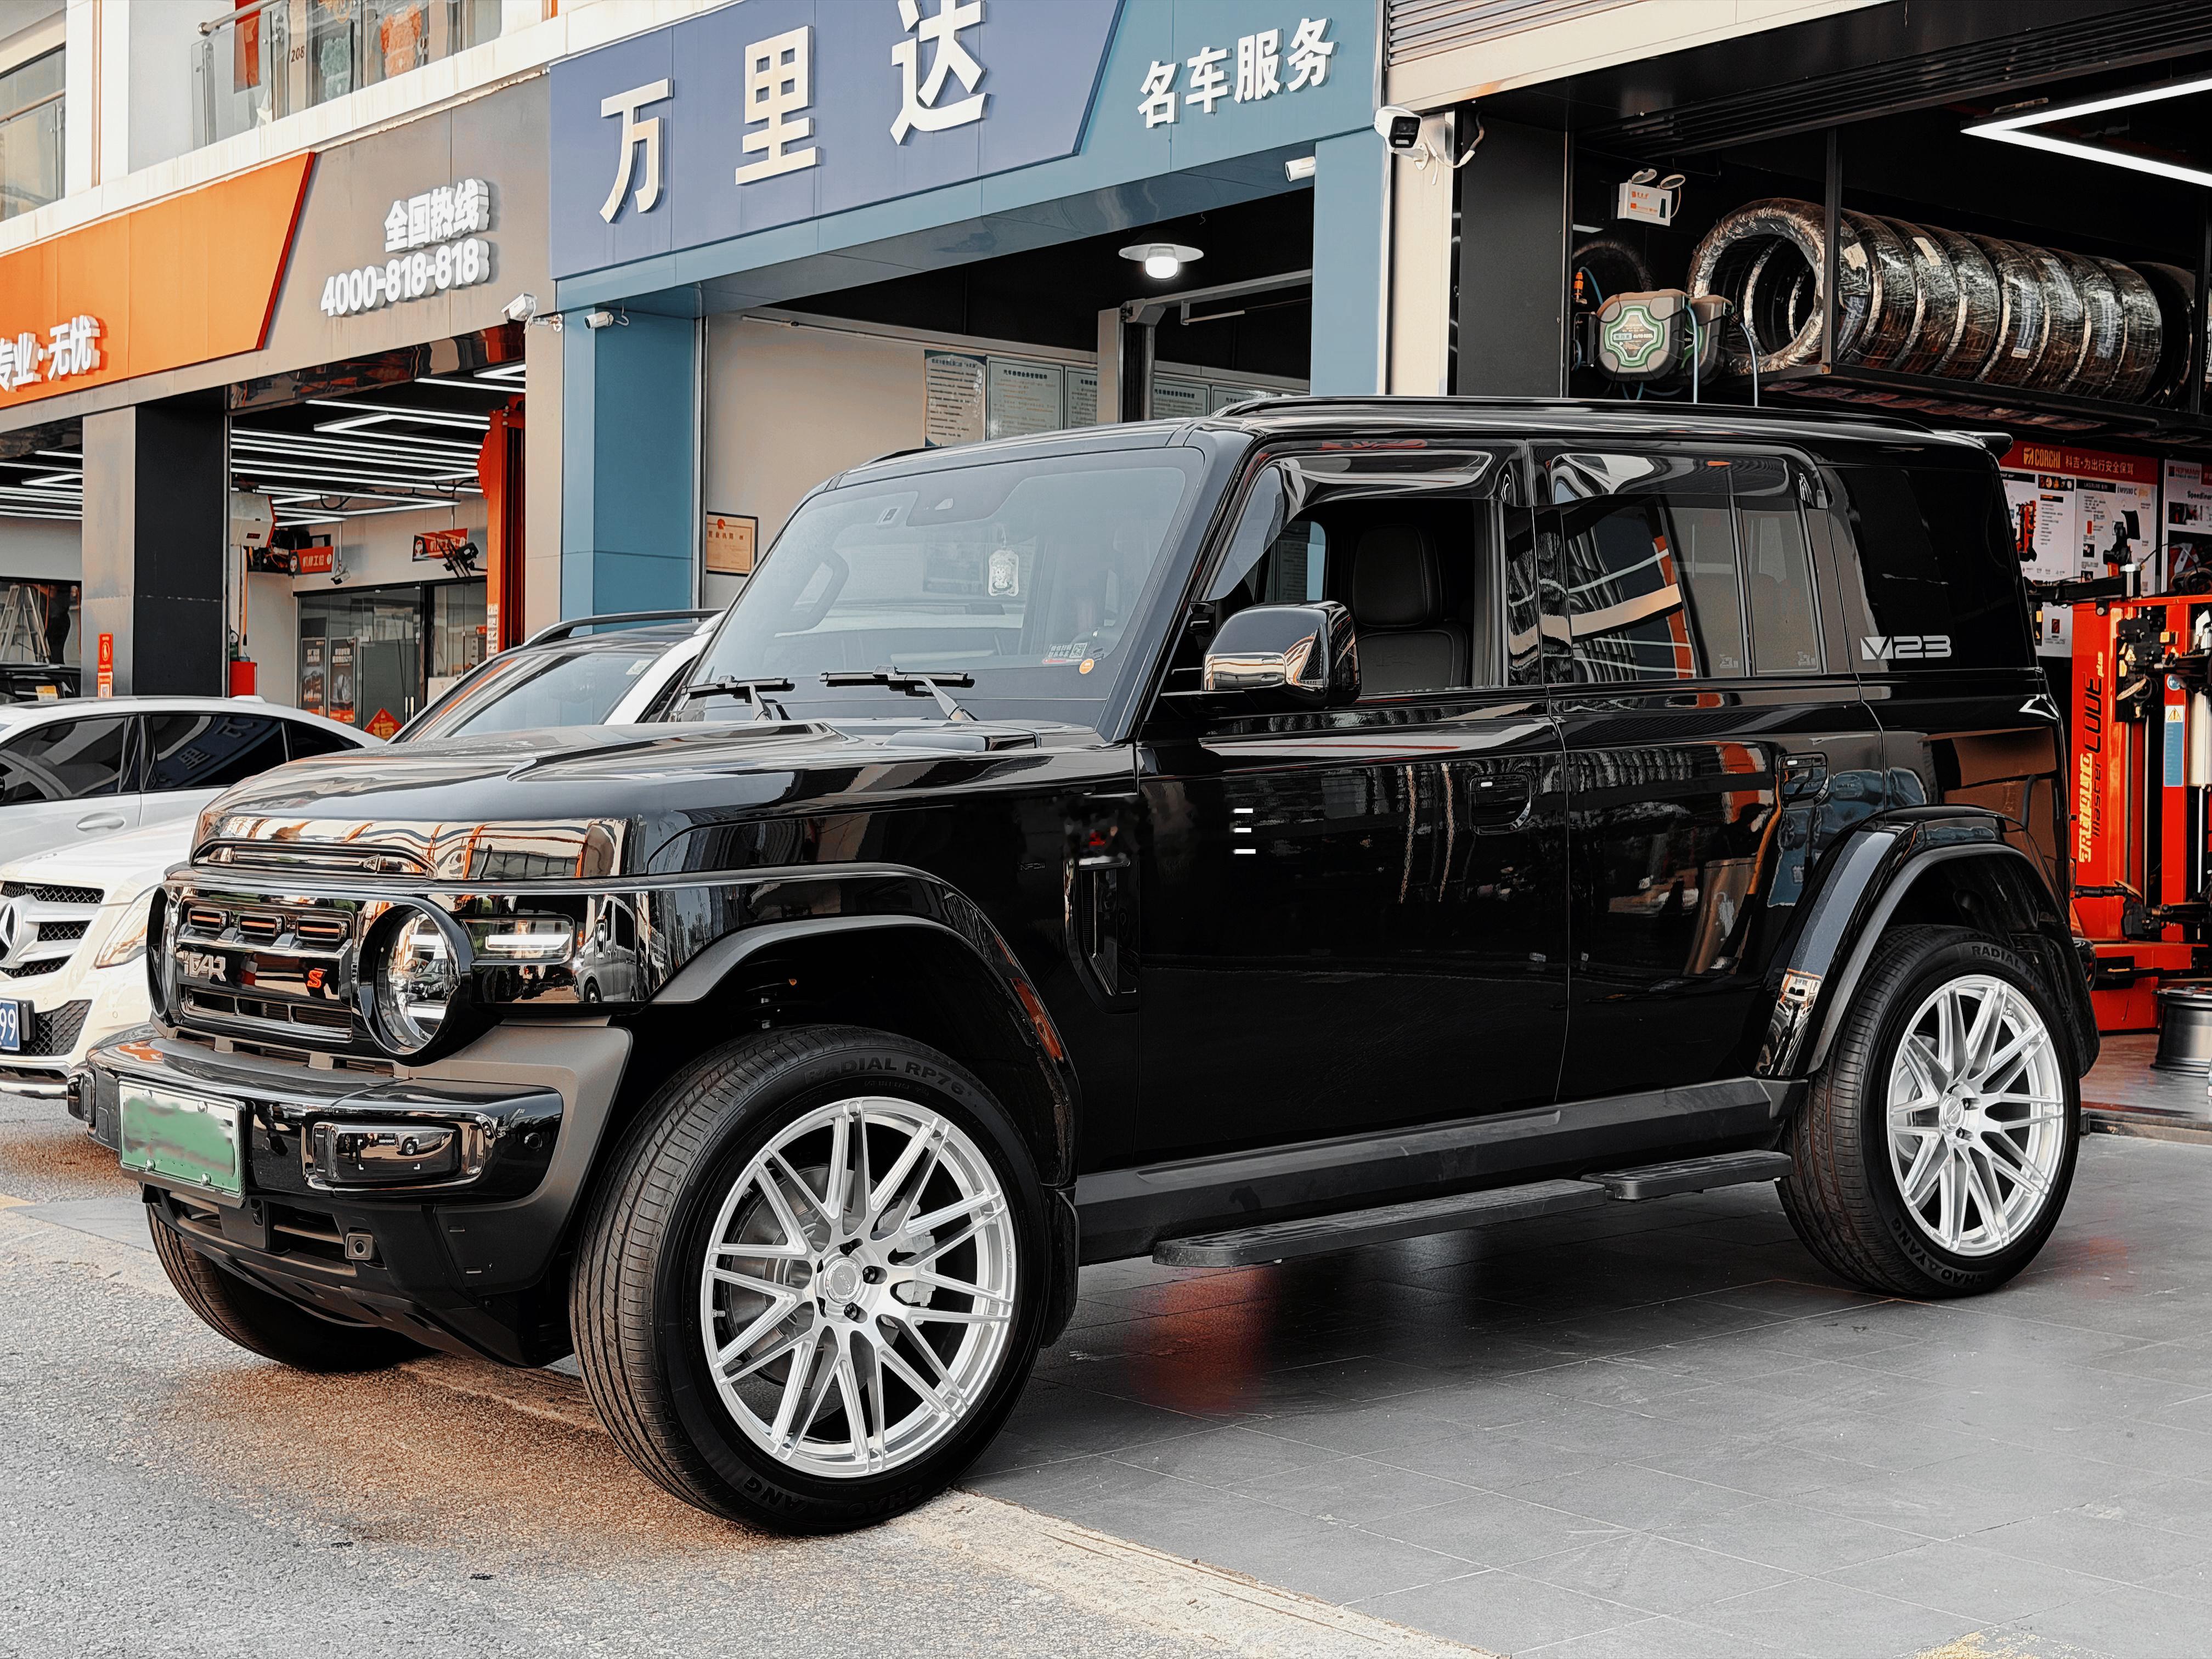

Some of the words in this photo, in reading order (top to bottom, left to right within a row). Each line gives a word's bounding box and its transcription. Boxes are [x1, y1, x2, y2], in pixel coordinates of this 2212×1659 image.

[291, 45, 305, 63] 208
[1138, 18, 1335, 128] 名车服务
[599, 0, 989, 223] 万里达
[384, 178, 479, 252] 全国热线
[320, 238, 480, 317] 4000-818-818
[2035, 448, 2061, 469] CORGHI
[2096, 651, 2104, 678] plus
[1971, 945, 2021, 970] RADIAL
[1891, 1217, 1928, 1267] YANG
